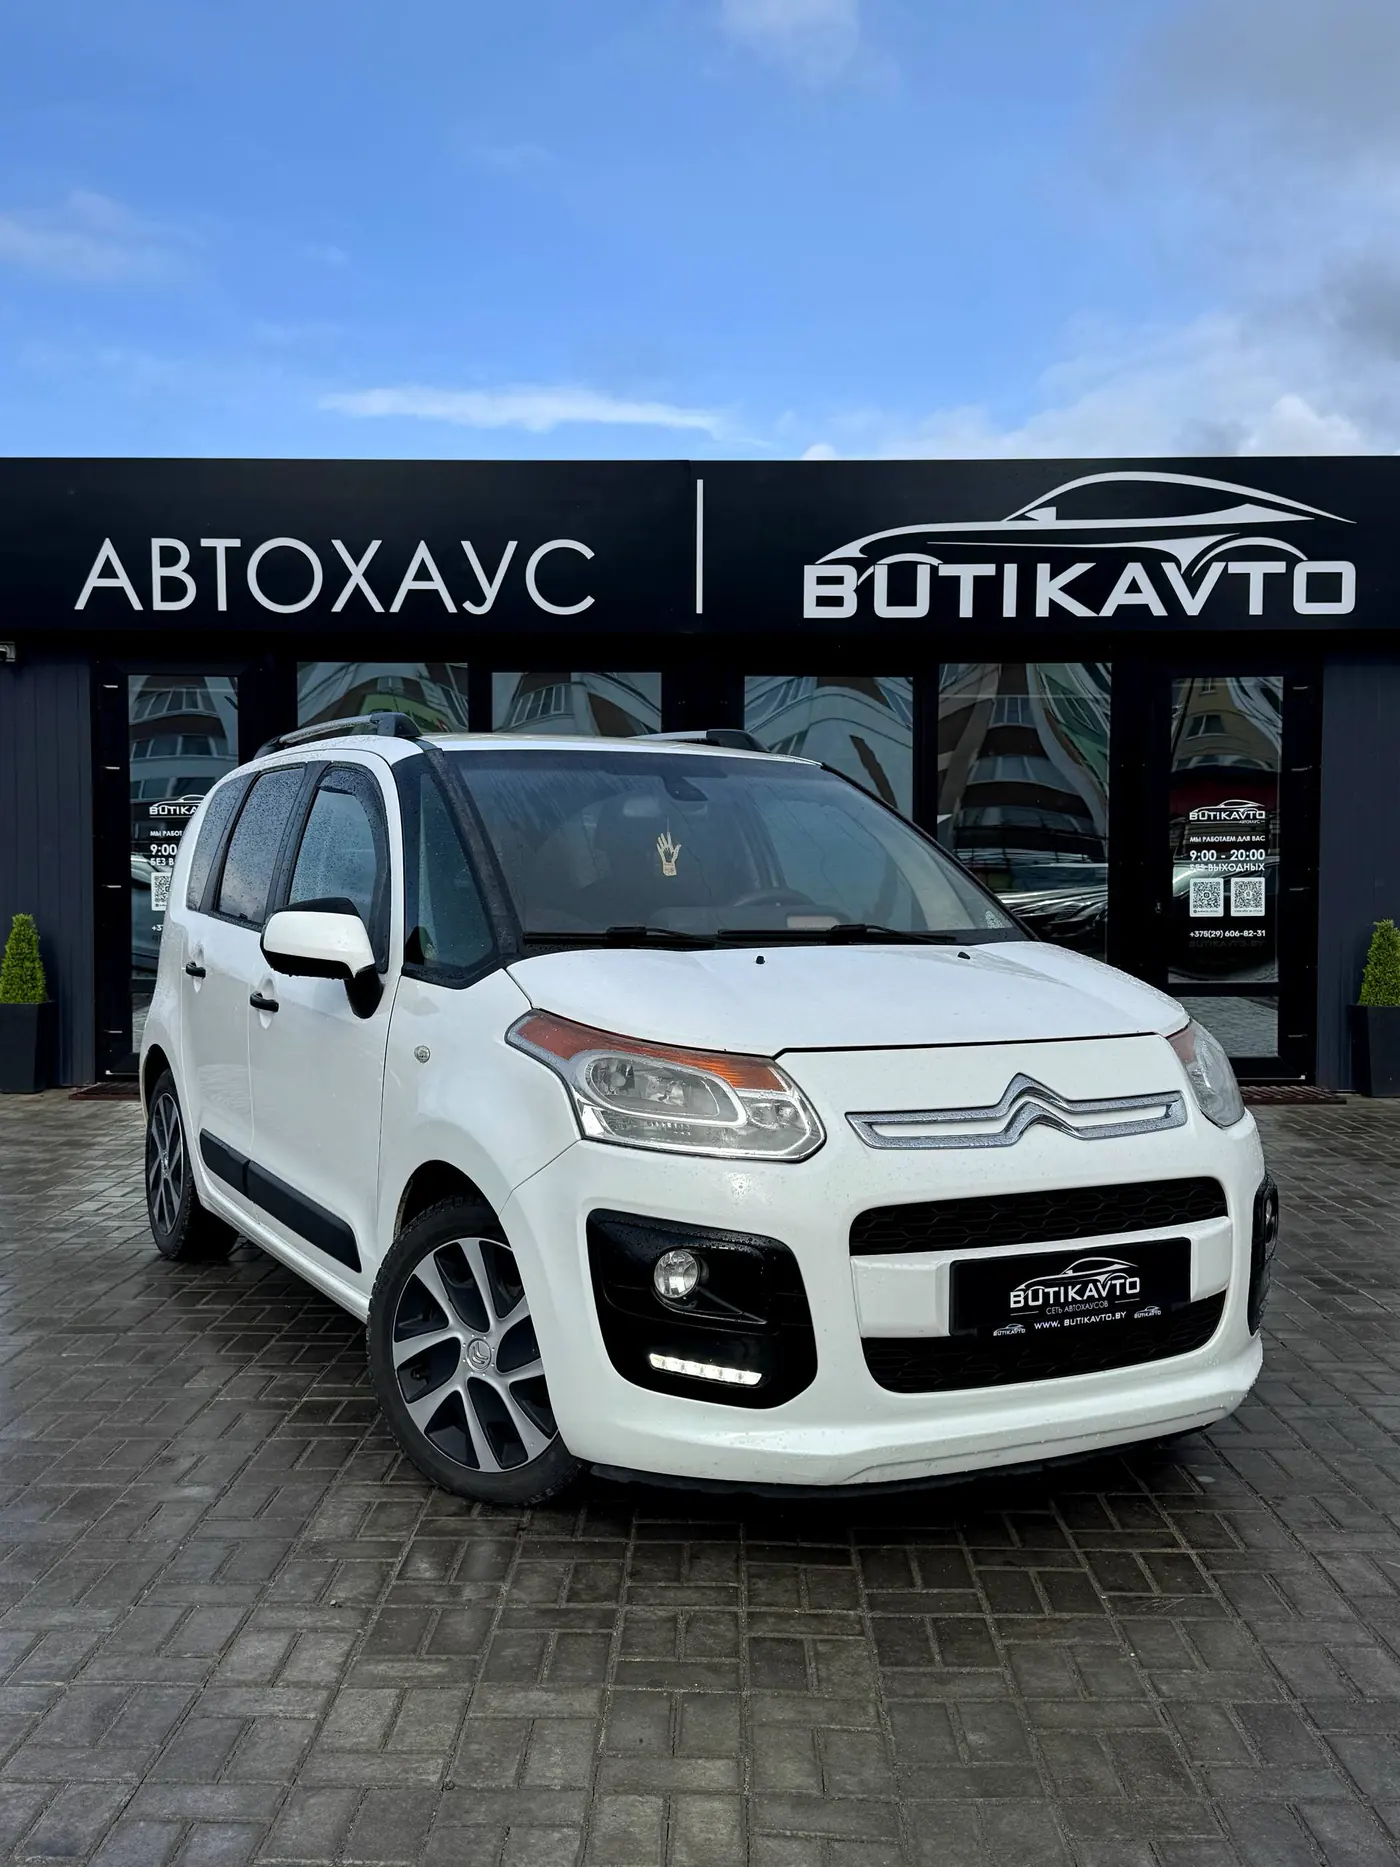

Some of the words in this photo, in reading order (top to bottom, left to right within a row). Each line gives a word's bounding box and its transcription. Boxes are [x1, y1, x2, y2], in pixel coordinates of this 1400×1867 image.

[74, 537, 596, 615] АВТОХАУС
[803, 560, 1356, 618] BUTIKAVTO
[1189, 811, 1265, 820] BUTIKAVTO
[150, 844, 177, 855] 9:00
[1189, 850, 1217, 861] 9:00
[1229, 849, 1266, 861] 20:00
[150, 858, 167, 866] БЕЗ
[1208, 862, 1266, 872] ВЫХОДНЫХ
[1189, 930, 1224, 938] +375(29)
[1224, 929, 1266, 938] 606-82-31
[1010, 1277, 1140, 1309] BUTIKAVTO
[1045, 1307, 1063, 1315] СЕТЬ
[1063, 1301, 1109, 1313] АВТОХАУСОВ
[1134, 1310, 1162, 1319] BUTIKAVTO
[1034, 1320, 1061, 1330] WWW.
[1063, 1311, 1127, 1327] BUTIKAVTO.BY
[993, 1328, 1026, 1337] BUTIKAVTO
